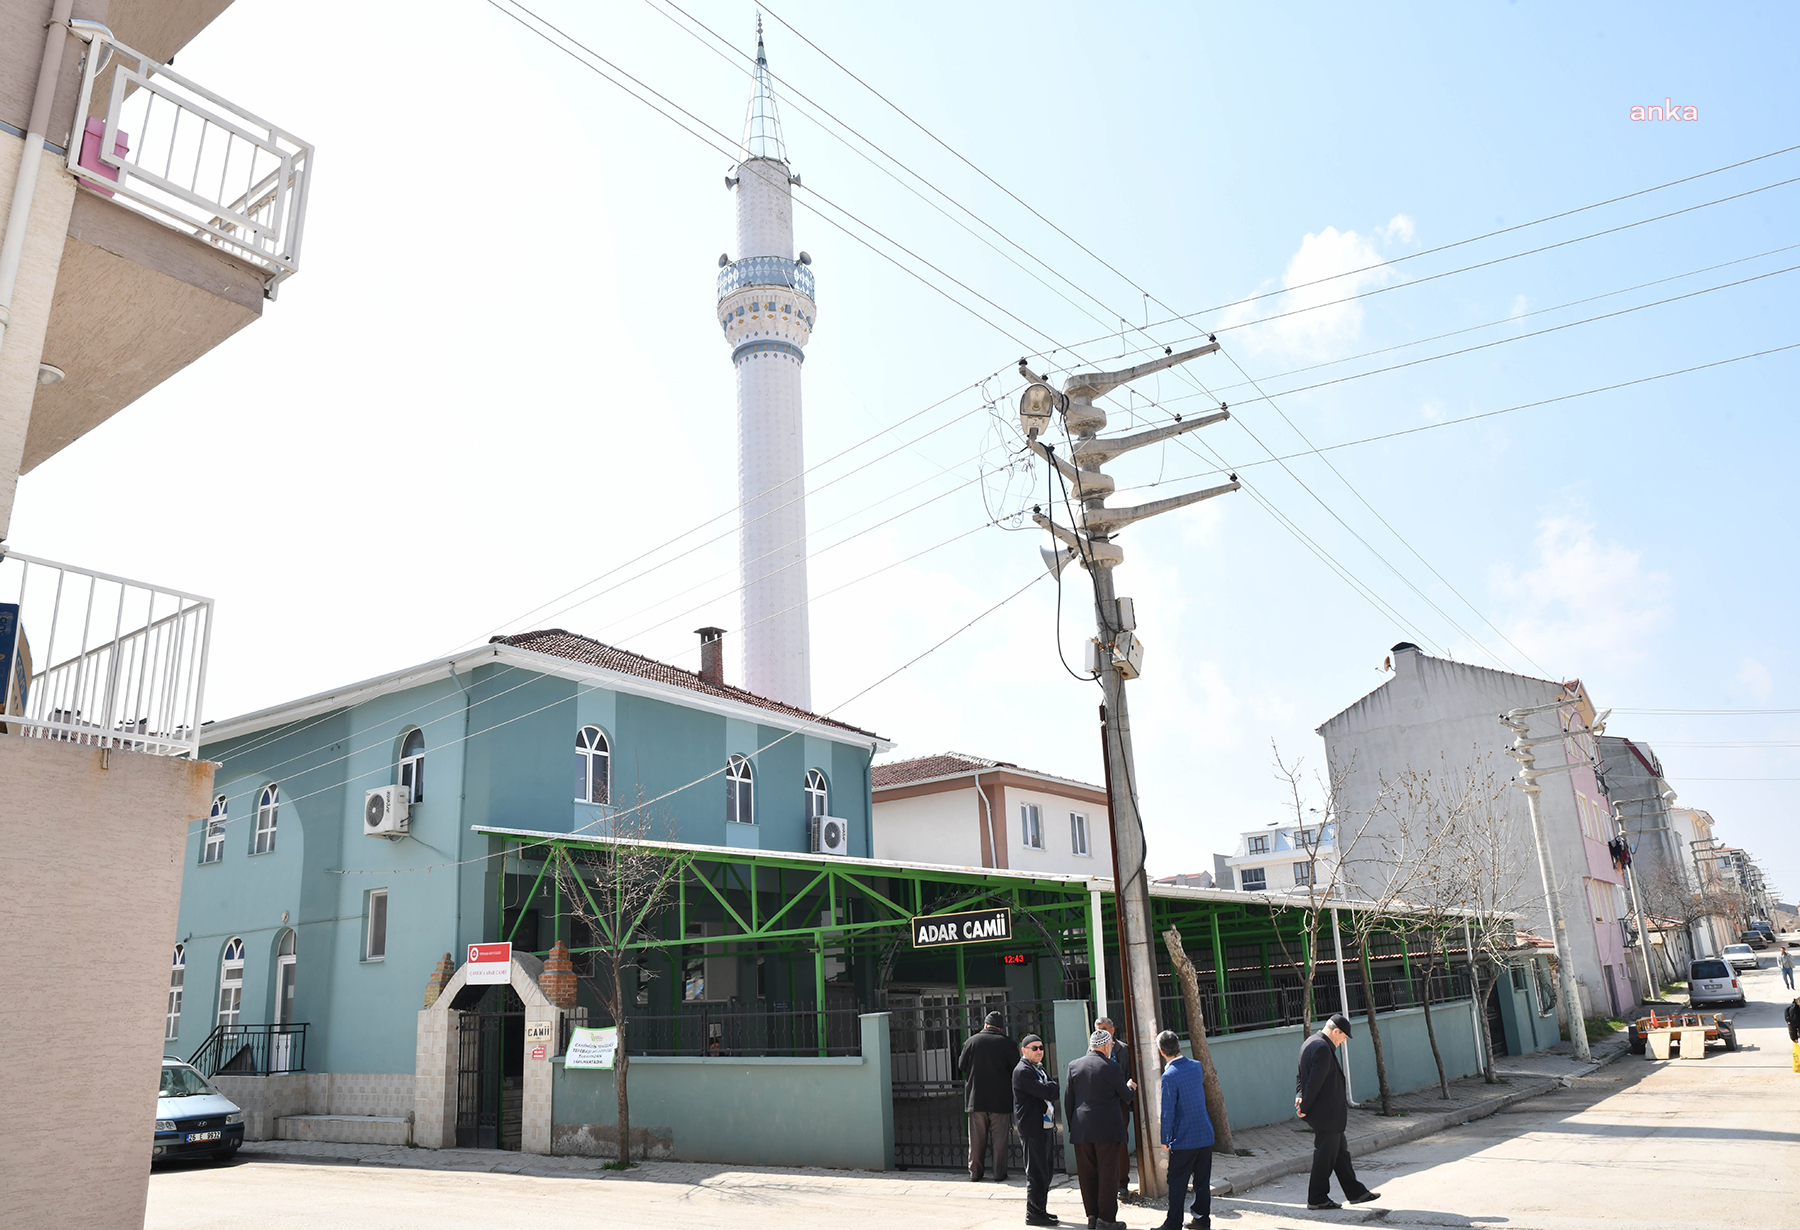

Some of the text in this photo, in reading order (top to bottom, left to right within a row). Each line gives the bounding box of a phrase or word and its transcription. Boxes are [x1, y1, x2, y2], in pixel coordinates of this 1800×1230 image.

[917, 913, 1006, 943] ADAR CAMİİ
[1004, 954, 1024, 964] 12:43
